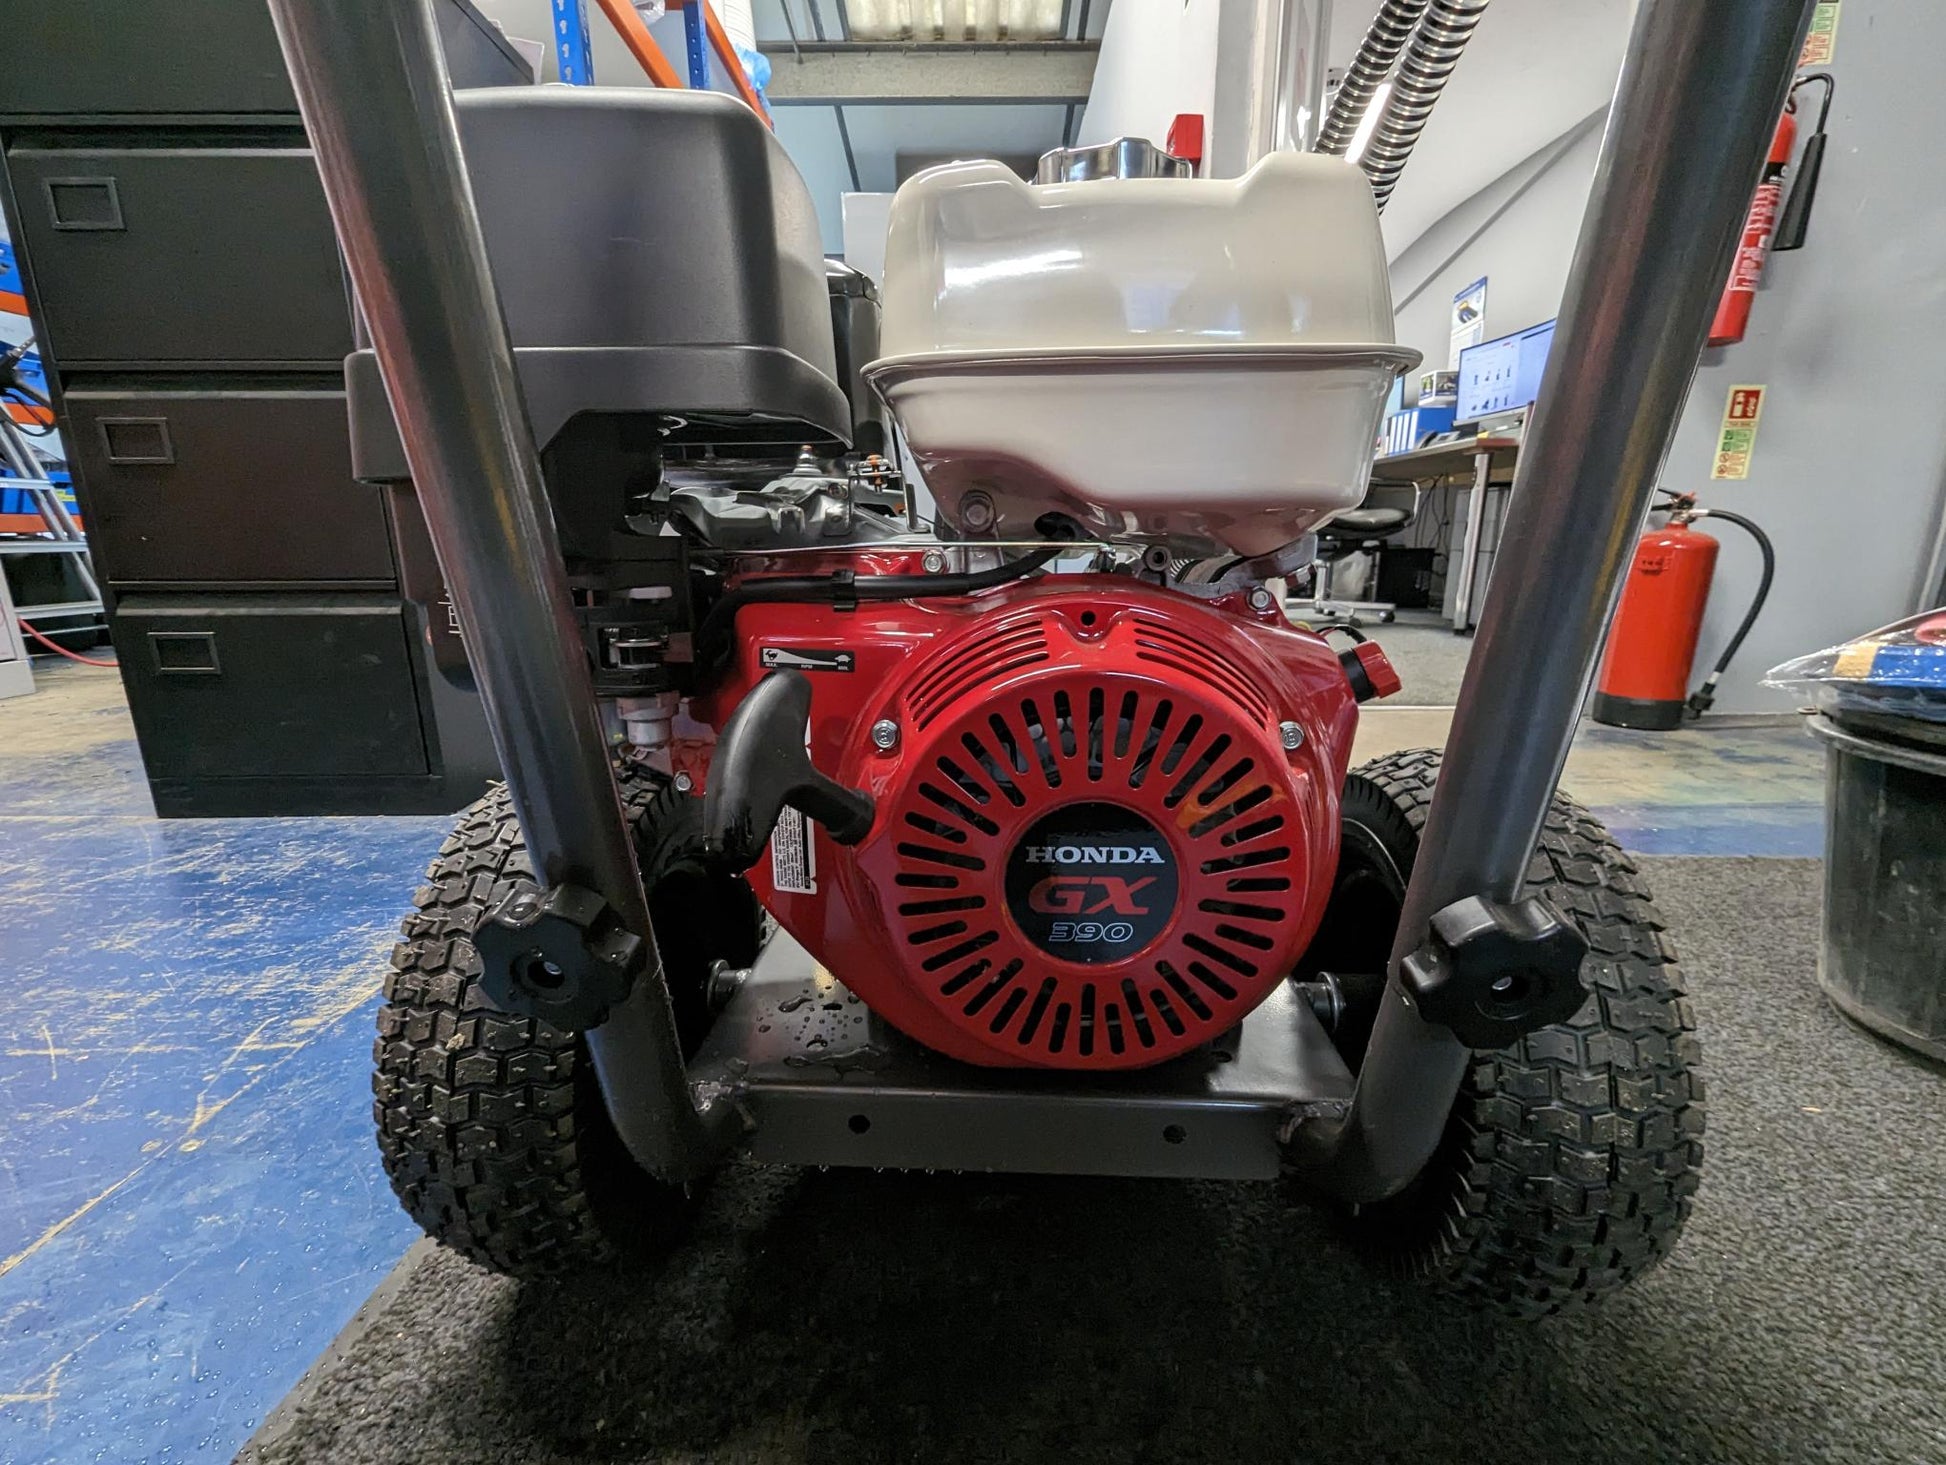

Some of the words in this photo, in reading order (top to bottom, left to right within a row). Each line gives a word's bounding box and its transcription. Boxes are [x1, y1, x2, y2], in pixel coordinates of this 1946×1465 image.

[1025, 846, 1165, 864] HONDA
[1028, 876, 1158, 915] GX
[1049, 922, 1134, 943] 390
